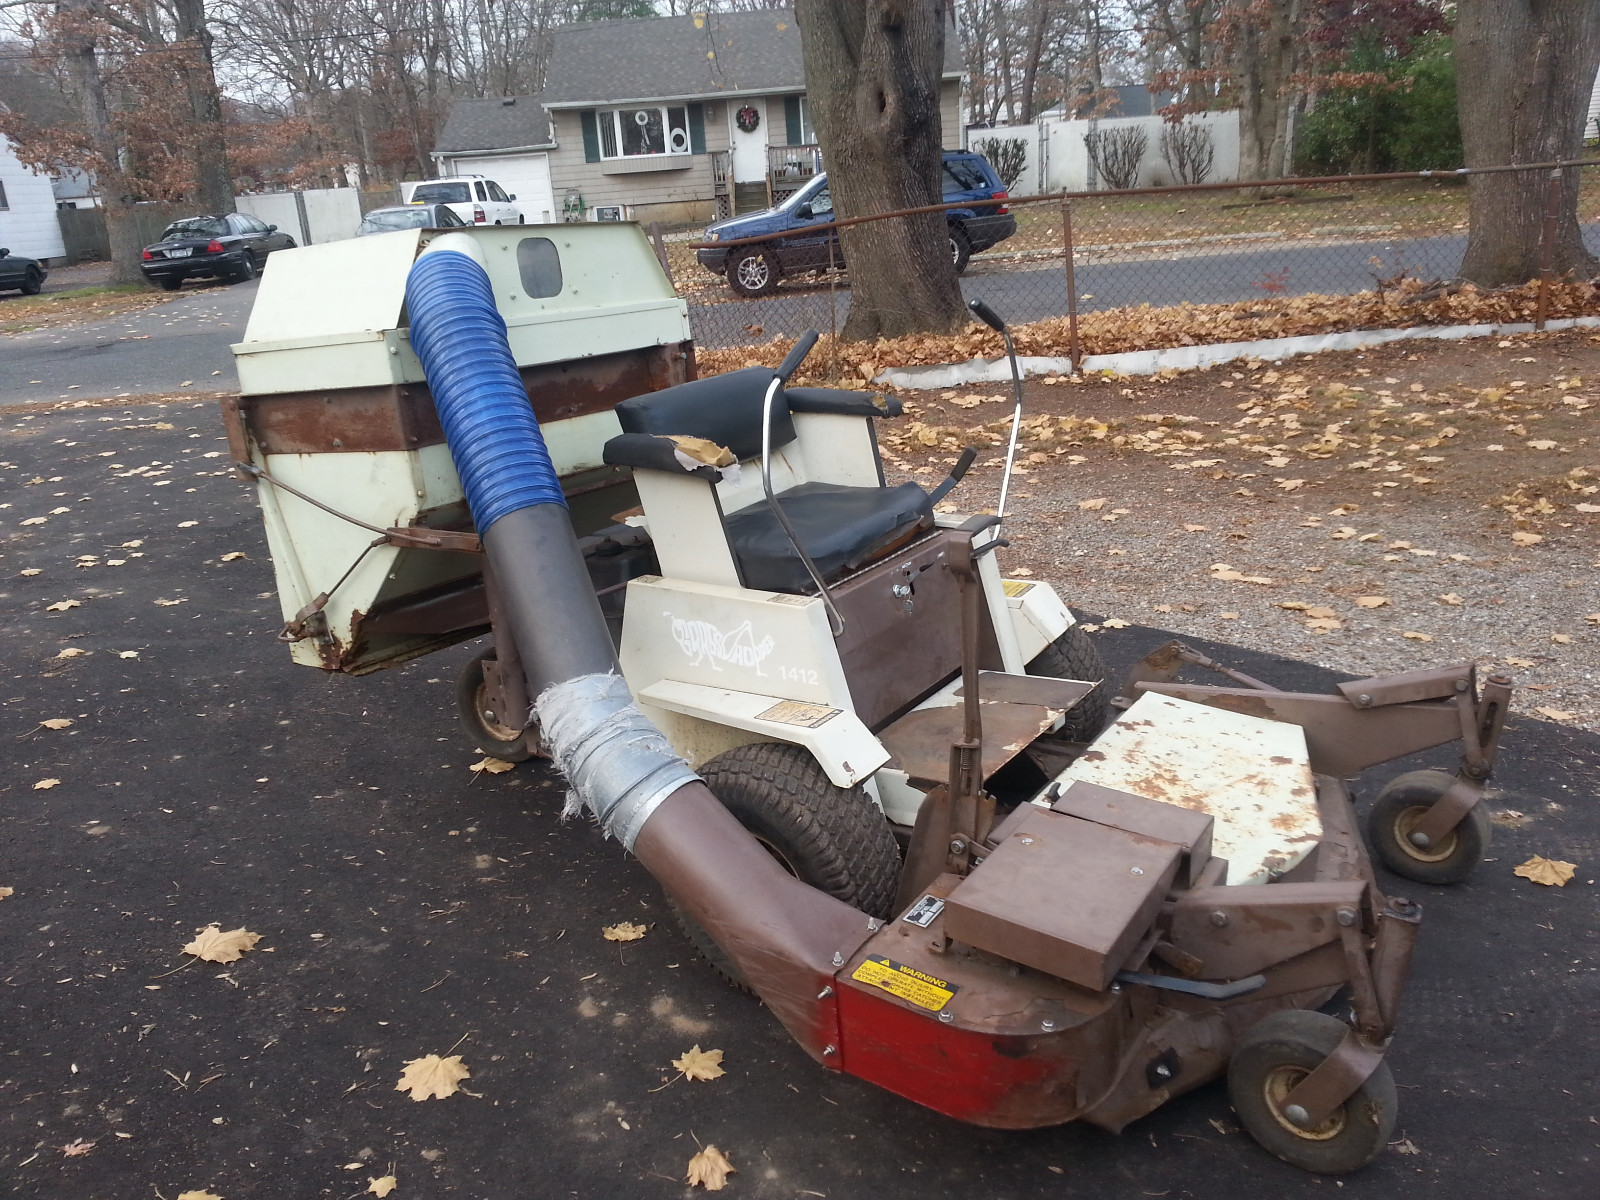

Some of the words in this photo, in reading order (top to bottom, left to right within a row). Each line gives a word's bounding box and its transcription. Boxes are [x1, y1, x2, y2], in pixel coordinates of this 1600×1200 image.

[778, 665, 819, 685] 1412
[872, 970, 886, 978] NOT
[887, 975, 914, 988] OPERATE
[917, 987, 945, 1001] WITHOUT
[889, 972, 909, 981] AVOID
[910, 979, 933, 991] INJURY
[899, 965, 948, 988] WARNING
[891, 982, 912, 993] GRASS
[913, 991, 943, 1005] CATCHER
[900, 991, 935, 1007] INSTALLED
